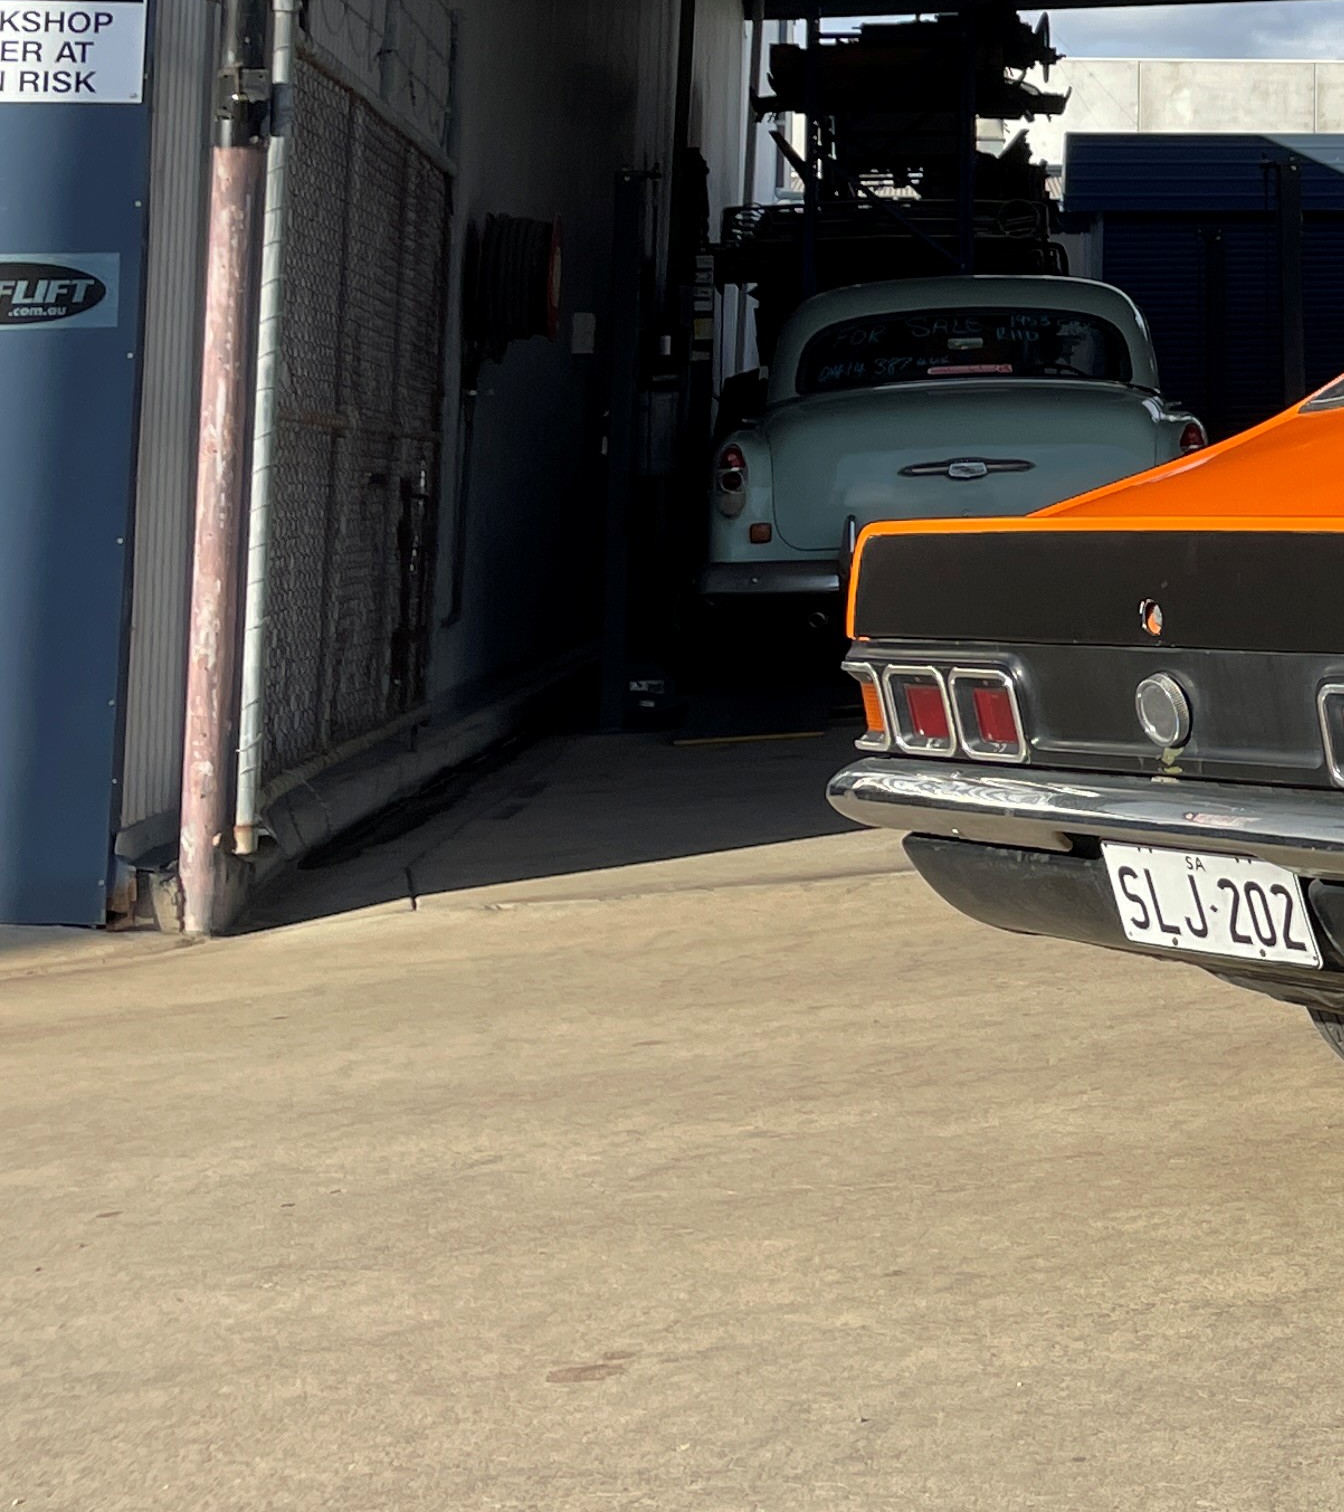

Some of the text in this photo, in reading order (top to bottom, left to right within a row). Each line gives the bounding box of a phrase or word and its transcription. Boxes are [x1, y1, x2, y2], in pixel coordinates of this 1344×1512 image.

[0, 10, 114, 34] KSHOP
[55, 41, 94, 64] AT
[19, 71, 97, 94] RISK
[904, 316, 984, 338] SALE
[1184, 855, 1207, 872] SA
